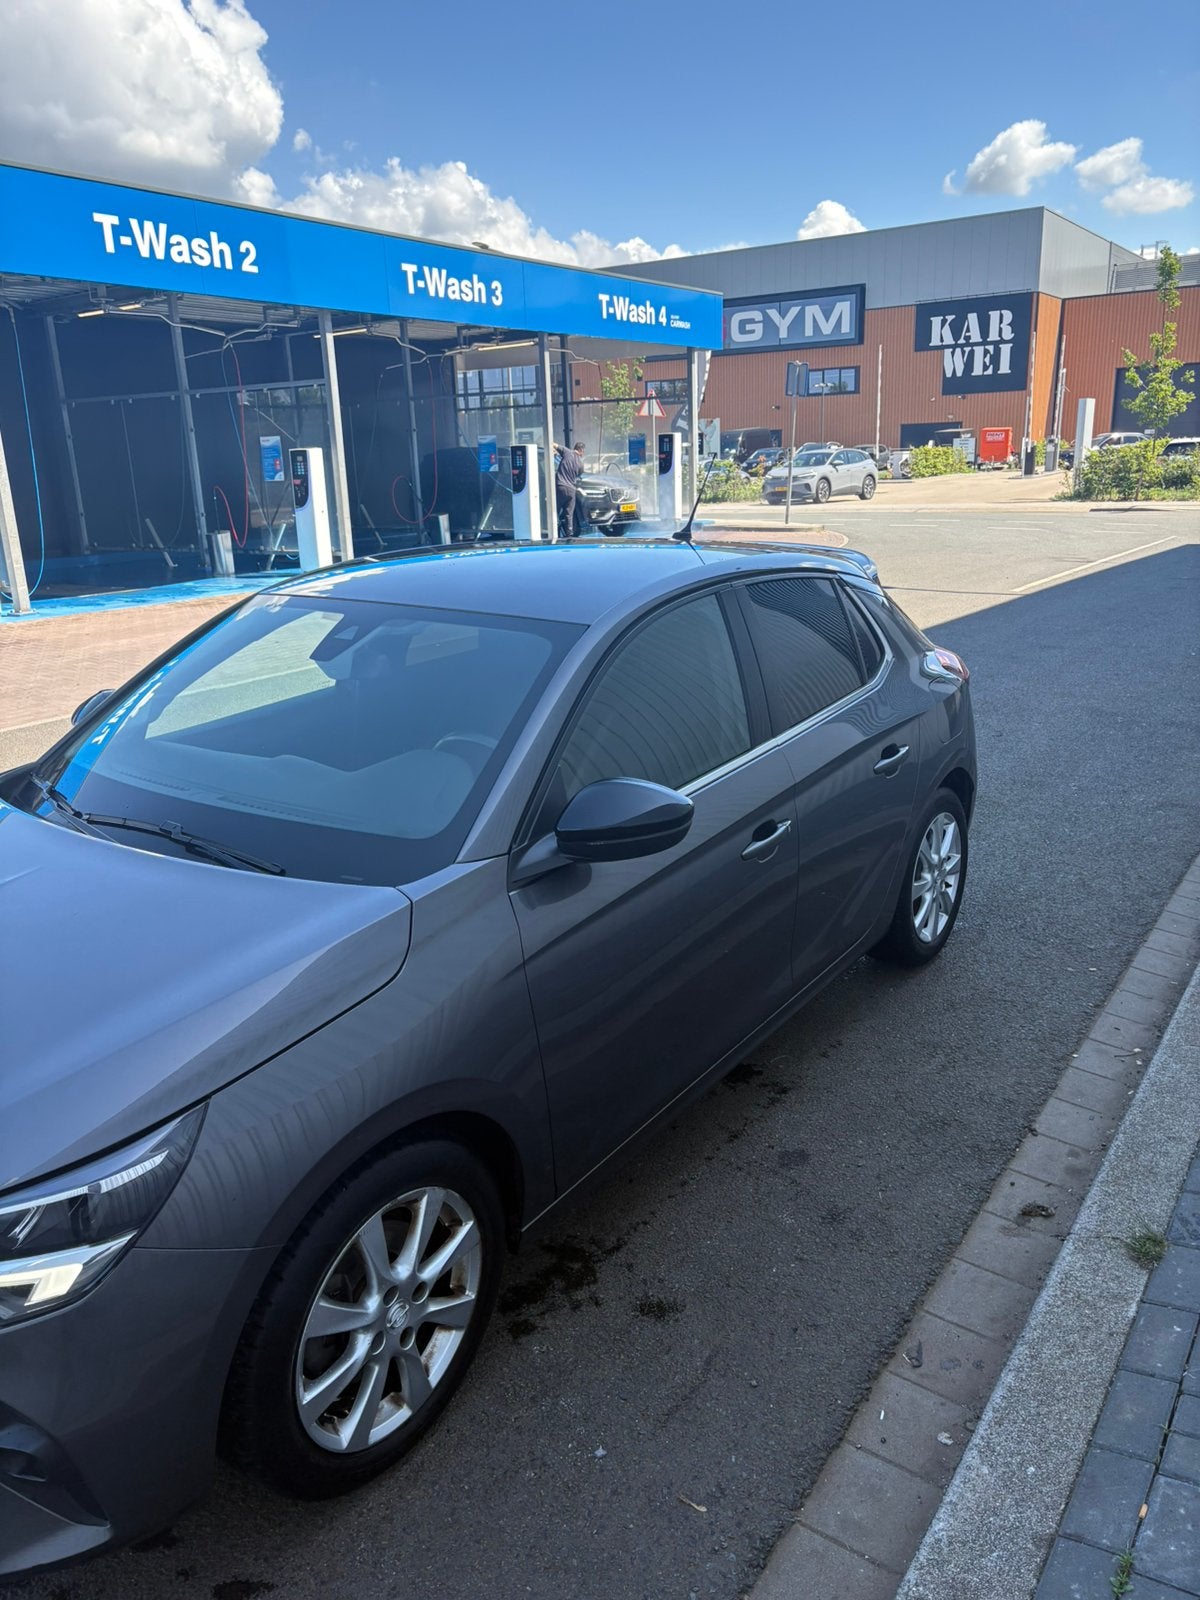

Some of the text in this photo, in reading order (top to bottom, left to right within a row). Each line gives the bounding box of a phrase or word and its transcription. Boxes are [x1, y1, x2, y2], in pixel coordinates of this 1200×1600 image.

[92, 212, 258, 274] T-Wash 2
[401, 263, 503, 307] T-Wash 3
[599, 293, 668, 327] T-Wash 4
[730, 302, 851, 343] GYM
[929, 310, 1014, 347] KAR
[943, 344, 1013, 377] WEI
